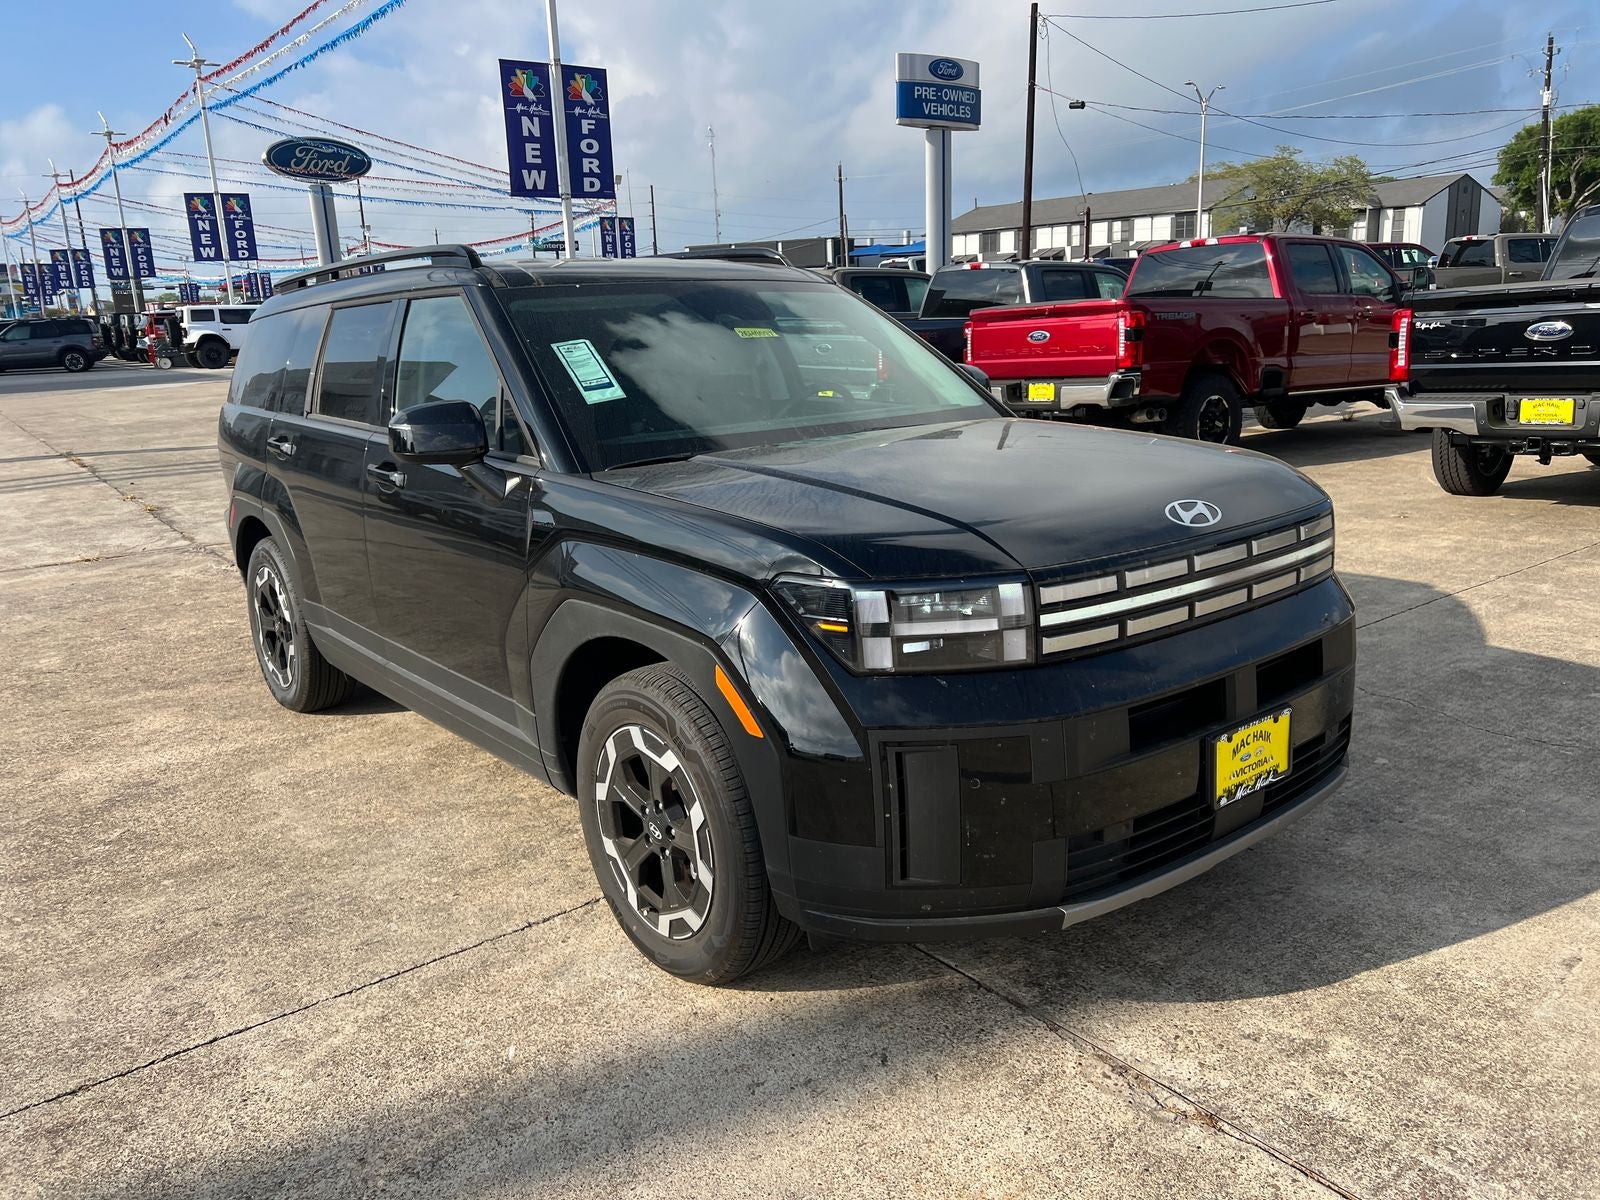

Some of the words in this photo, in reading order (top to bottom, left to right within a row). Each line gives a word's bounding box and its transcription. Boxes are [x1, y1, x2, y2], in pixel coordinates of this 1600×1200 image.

[937, 62, 958, 76] Ford
[914, 86, 976, 104] PRE-OWNED
[922, 102, 971, 118] VEHICLES
[290, 145, 351, 174] Ford
[521, 116, 547, 190] NEW
[579, 119, 601, 193] FORD
[197, 220, 215, 258] NEW
[234, 220, 249, 258] FORD
[109, 248, 124, 276] NEW
[137, 247, 149, 276] FORD
[25, 276, 36, 295] NEW
[57, 264, 70, 287] NEW
[79, 264, 90, 287] FORD
[1155, 311, 1197, 321] TREMOR
[1232, 733, 1251, 761] MAC
[1252, 729, 1272, 744] HAIK
[1235, 756, 1269, 779] VICTORIA
